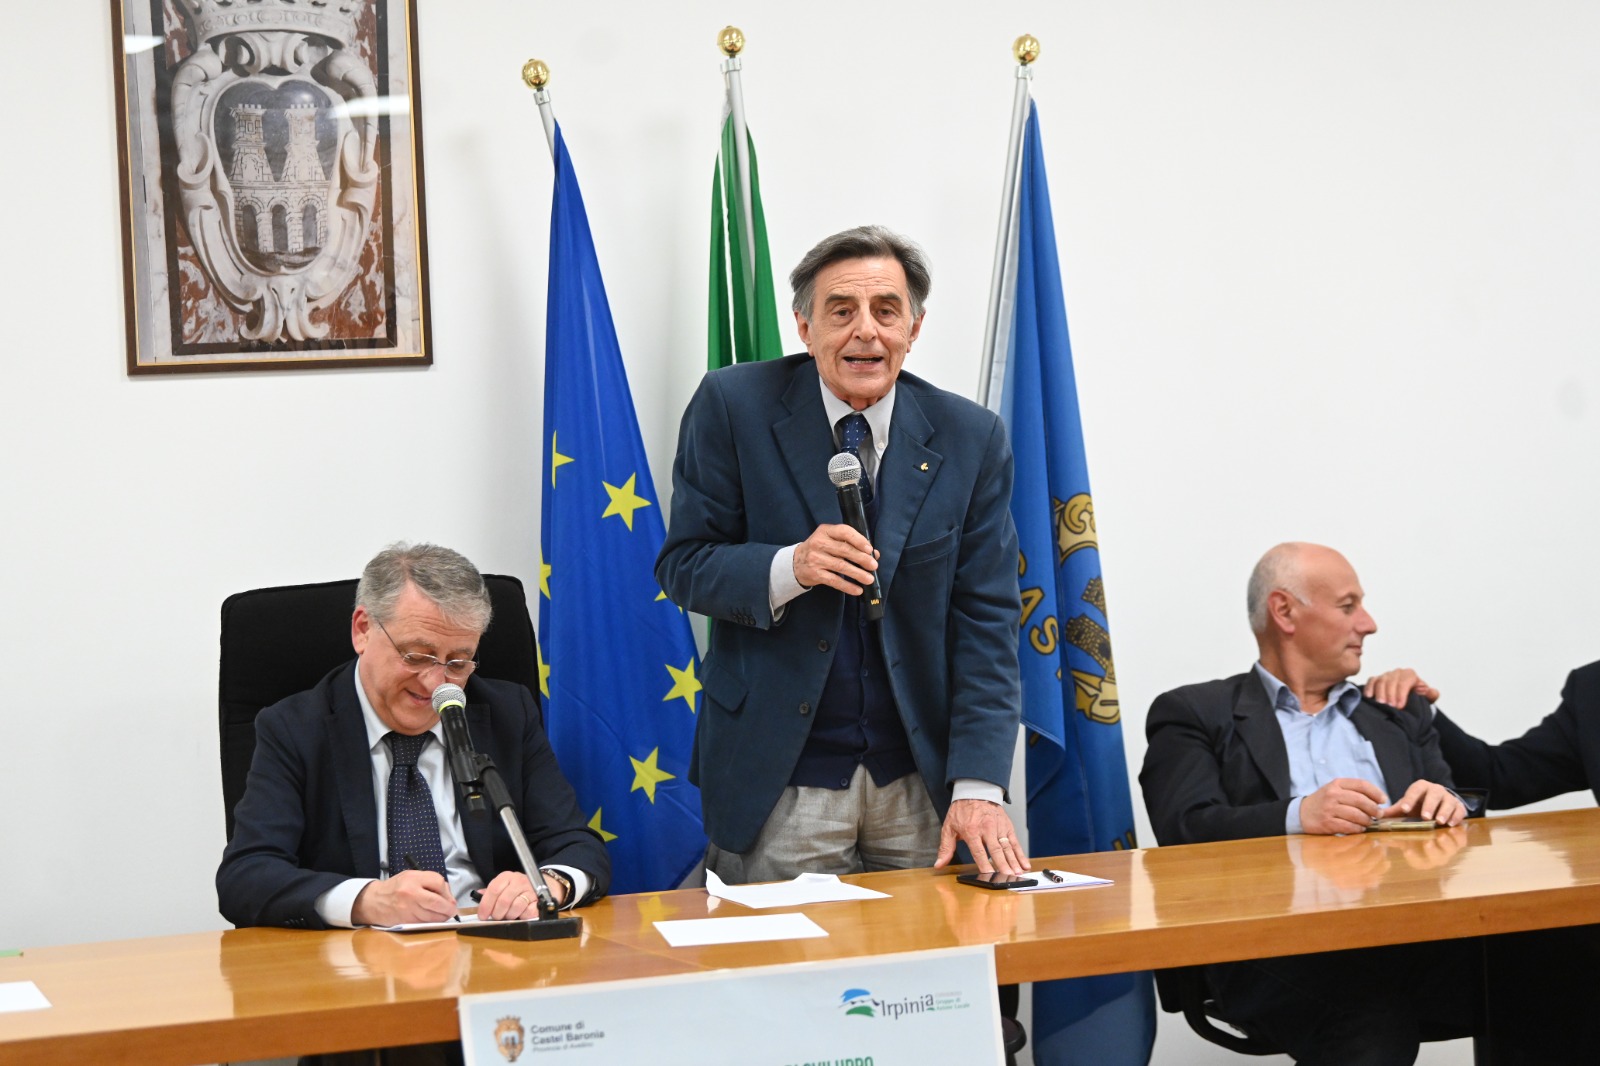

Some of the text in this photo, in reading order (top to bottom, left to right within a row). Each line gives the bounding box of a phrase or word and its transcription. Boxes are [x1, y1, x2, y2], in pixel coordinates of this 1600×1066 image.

[881, 993, 934, 1021] Irpinia
[530, 1020, 585, 1034] Comune di
[531, 1029, 605, 1045] Castel Baronia
